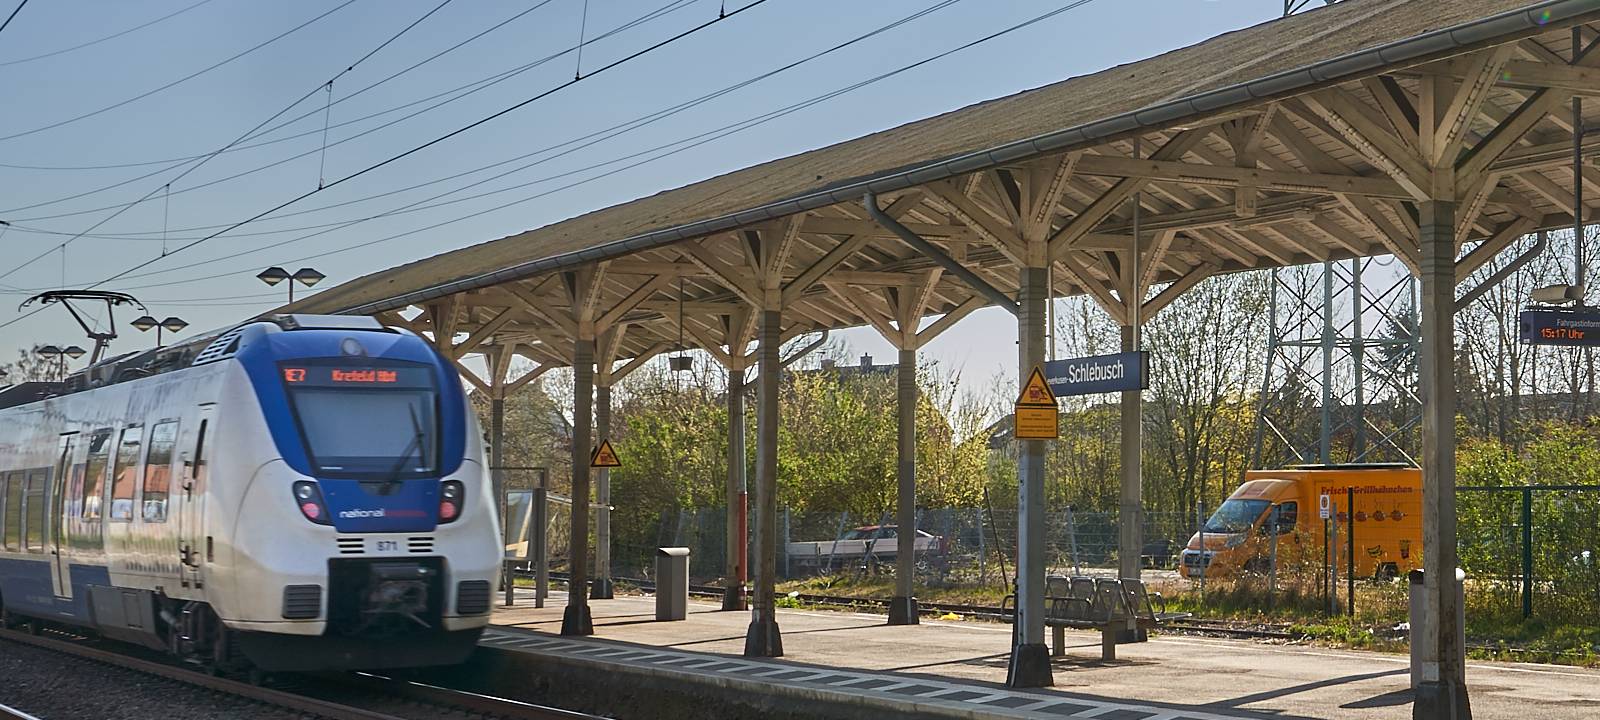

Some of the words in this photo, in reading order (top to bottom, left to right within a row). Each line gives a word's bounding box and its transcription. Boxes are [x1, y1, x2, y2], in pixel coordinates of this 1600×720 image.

[1541, 328, 1566, 338] 15:17
[1568, 329, 1584, 339] Uhr
[1321, 486, 1348, 496] Frisch
[339, 508, 385, 518] national
